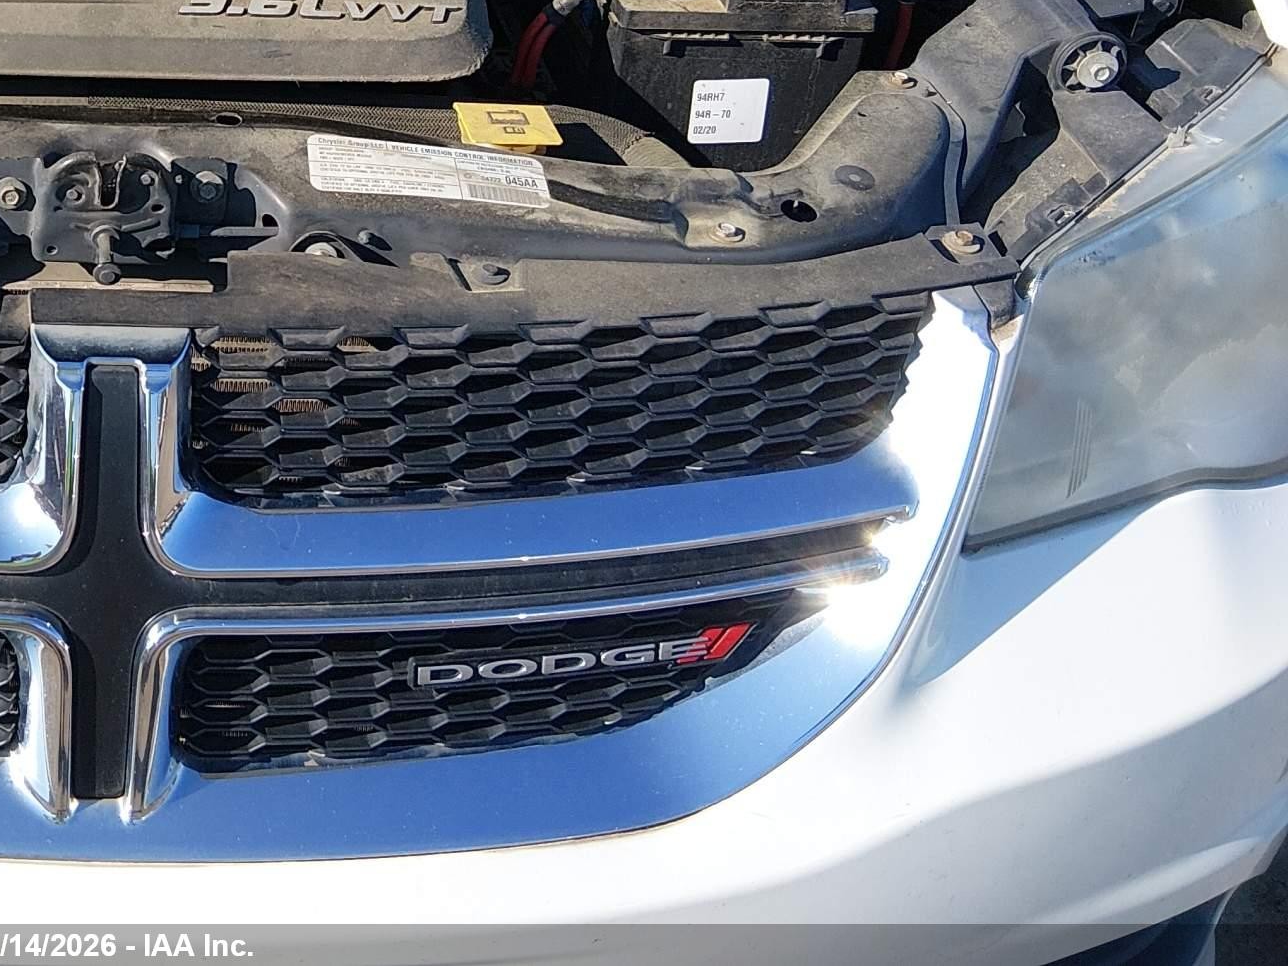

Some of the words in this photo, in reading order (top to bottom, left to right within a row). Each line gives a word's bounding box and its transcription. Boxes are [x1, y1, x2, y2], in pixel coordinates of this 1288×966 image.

[696, 92, 726, 102] 94RH7
[721, 109, 732, 119] 70
[692, 125, 717, 135] 02/20
[318, 137, 346, 146] Chrysler
[348, 140, 369, 148] Group
[391, 145, 419, 153] VEHICLE
[420, 148, 453, 157] EMISSION
[454, 151, 484, 161] CONTROL
[486, 154, 534, 166] INFORMATION
[416, 636, 711, 686] DODGE
